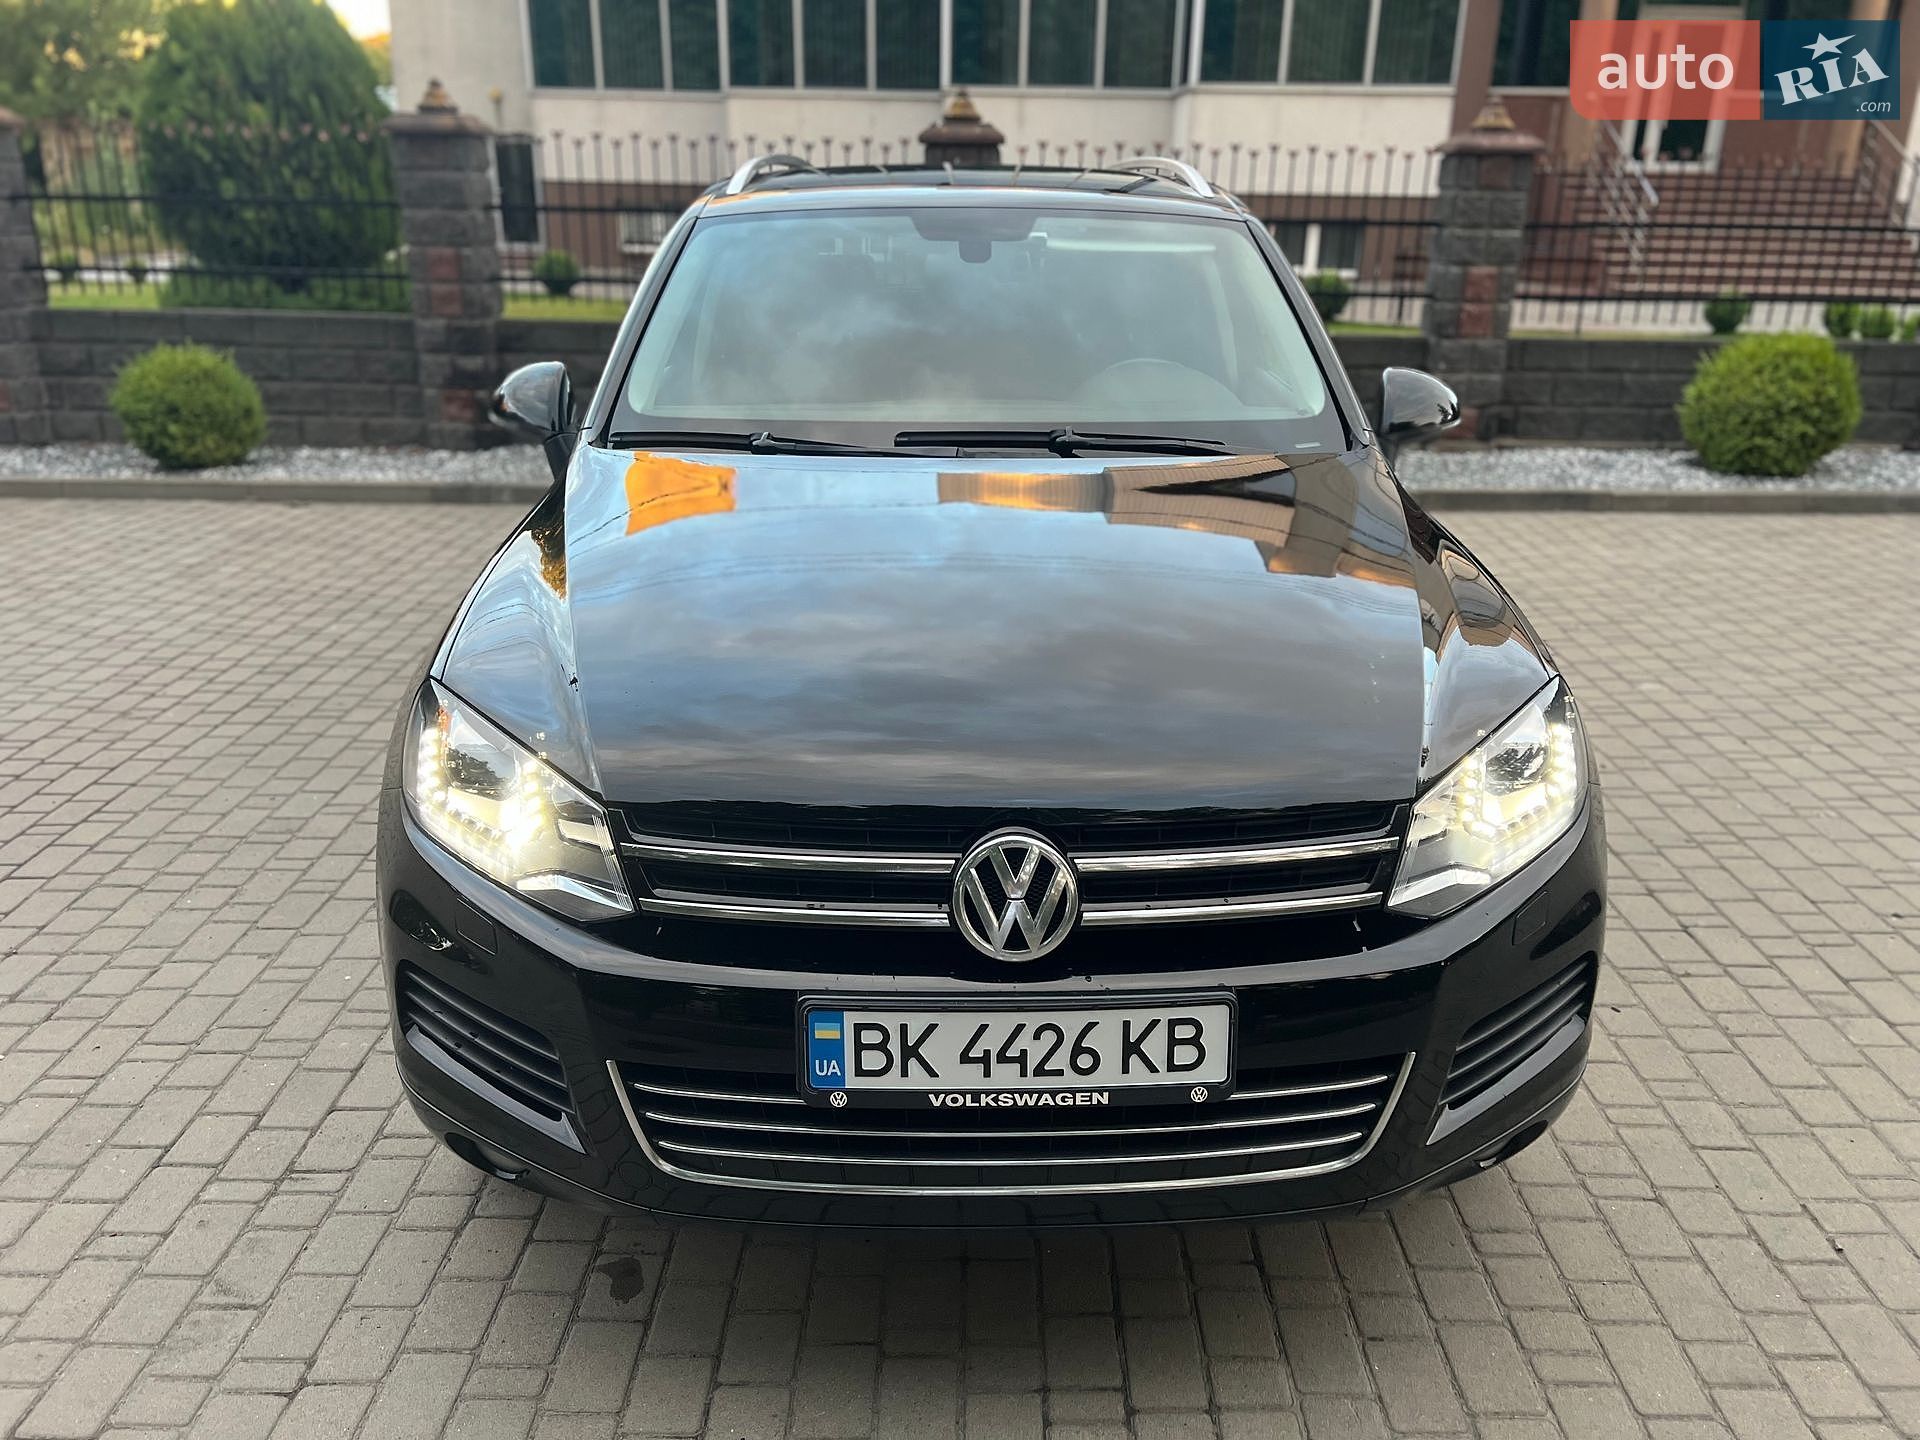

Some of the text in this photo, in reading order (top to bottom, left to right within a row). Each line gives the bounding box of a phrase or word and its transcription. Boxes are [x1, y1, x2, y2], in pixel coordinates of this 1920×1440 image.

[853, 1017, 1207, 1078] BK 4426 KB
[815, 1060, 841, 1076] UA
[928, 1091, 1109, 1107] VOLKSWAGEN
